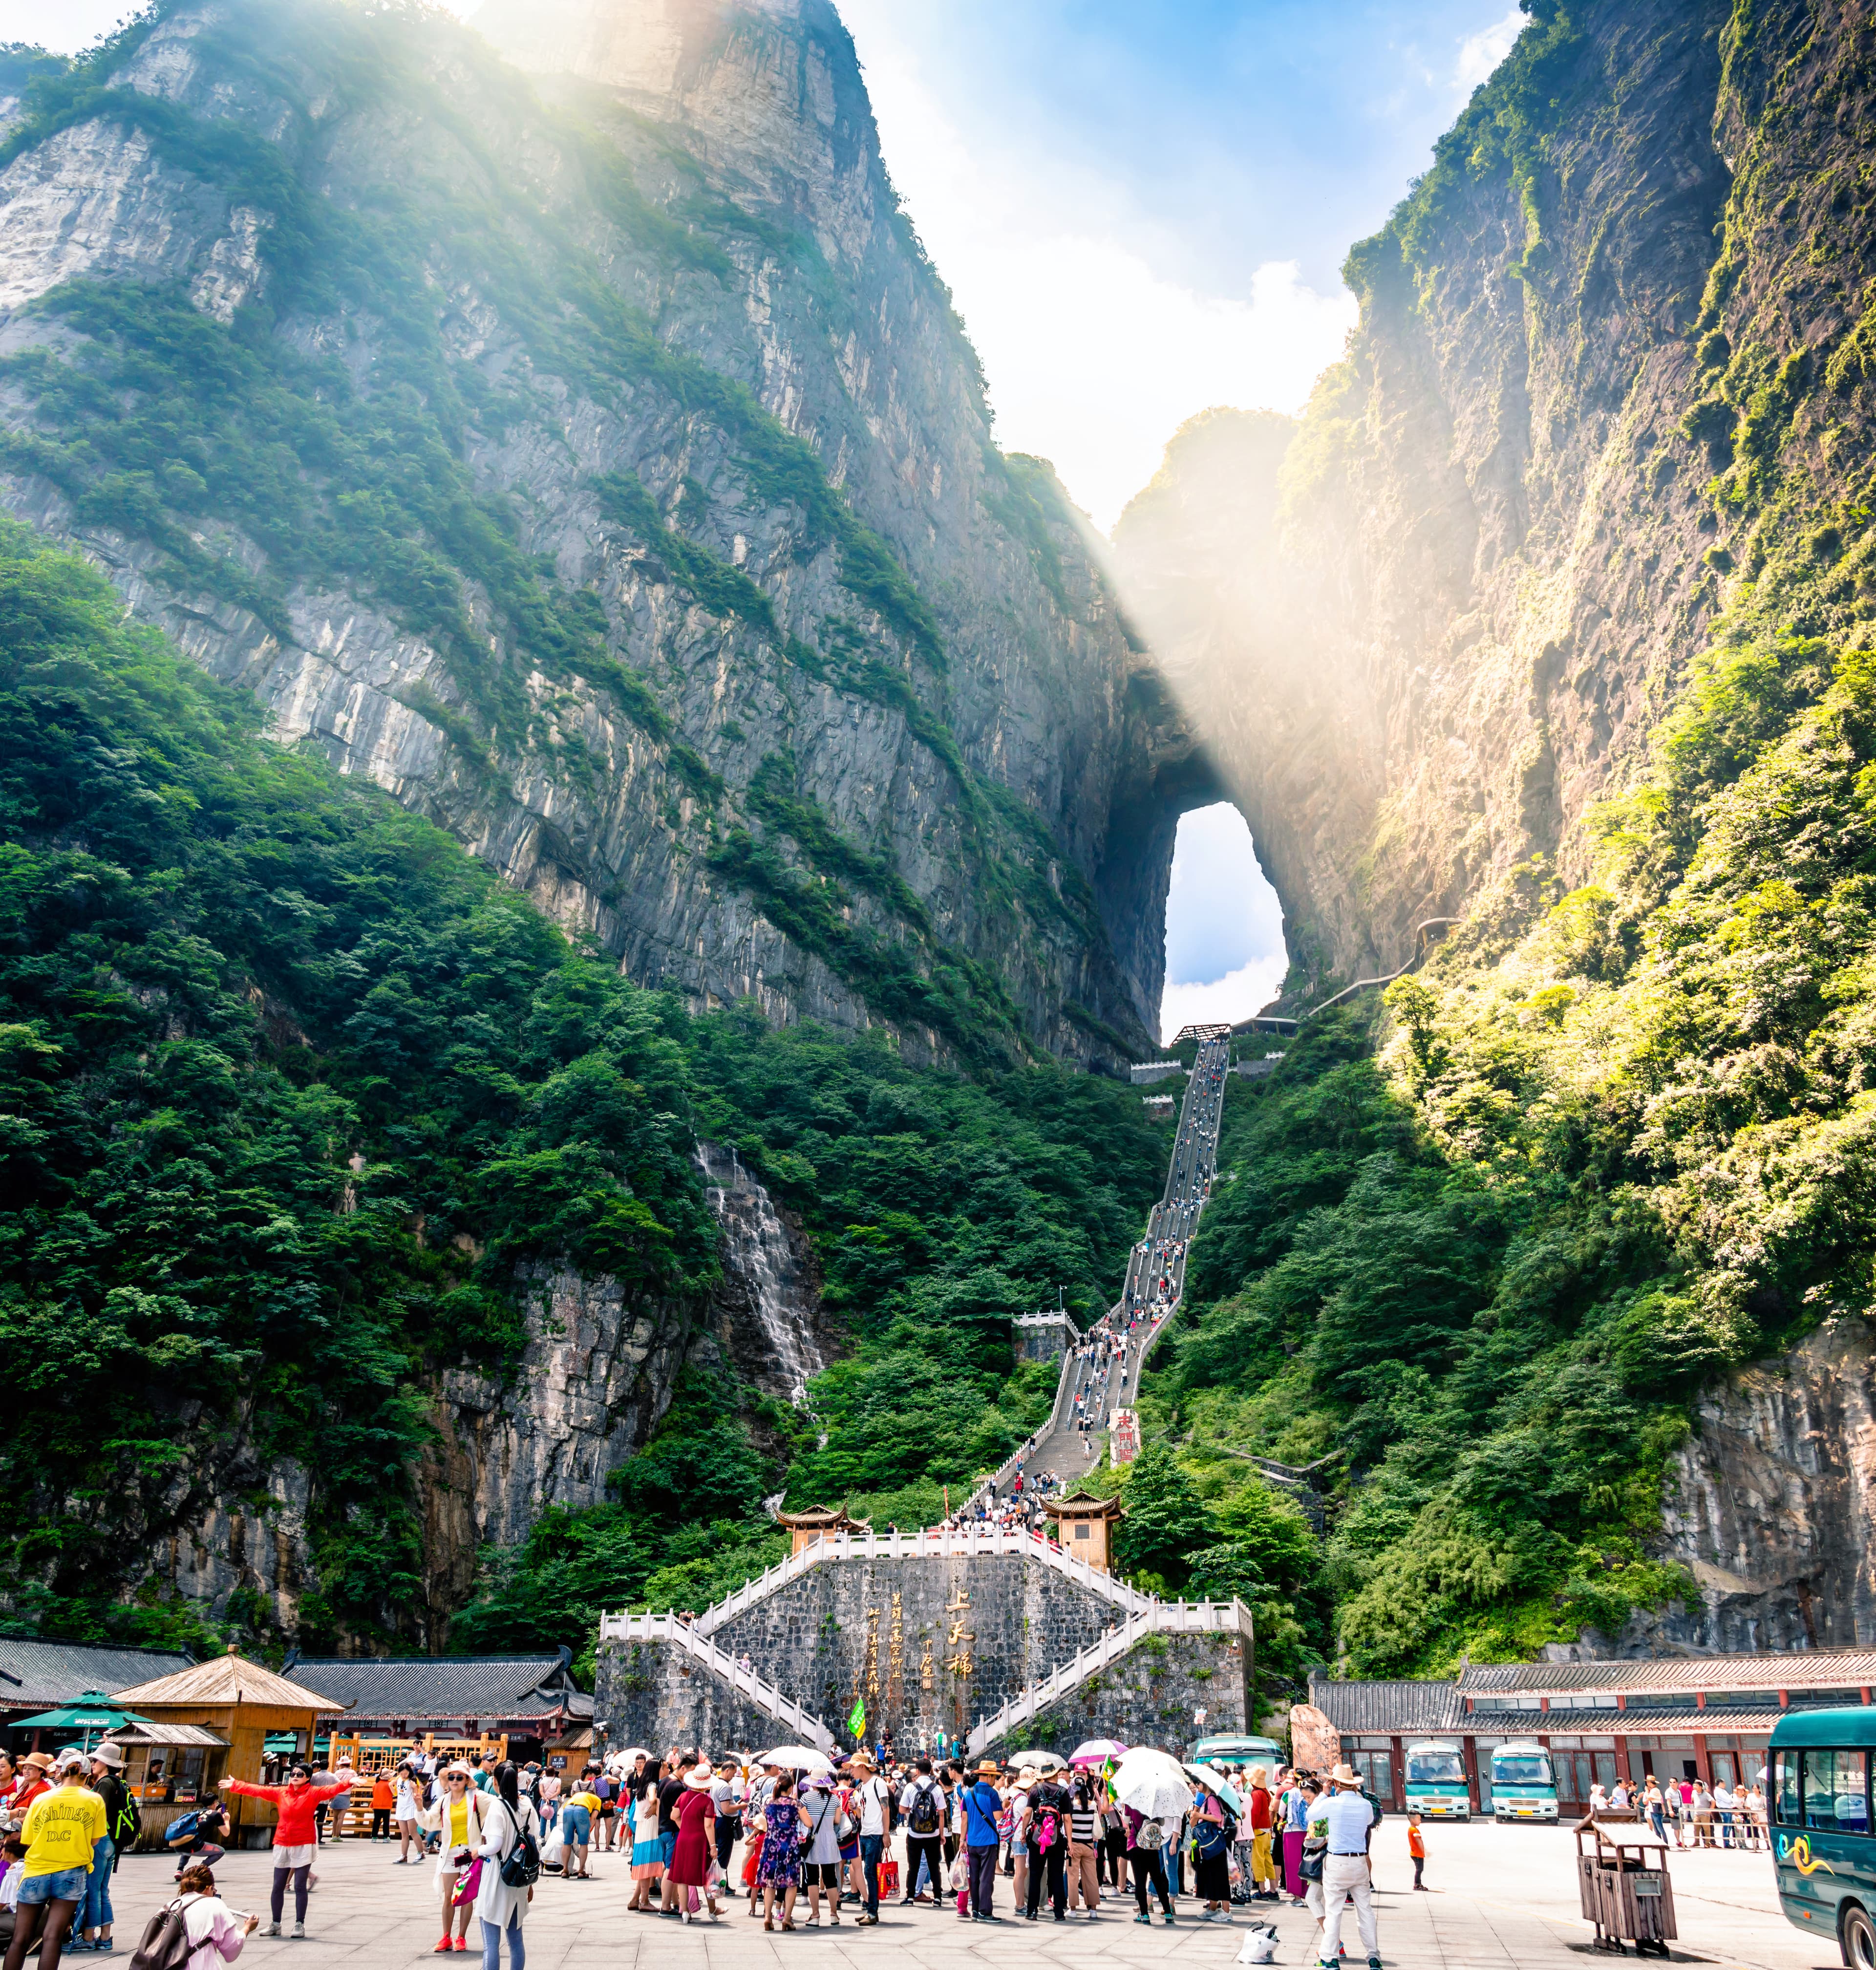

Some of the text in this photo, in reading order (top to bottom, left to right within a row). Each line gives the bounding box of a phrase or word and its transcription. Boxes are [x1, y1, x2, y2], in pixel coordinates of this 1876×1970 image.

[1118, 1416, 1133, 1461] 天門聖
[944, 1589, 974, 1681] 上天梯
[46, 1830, 71, 1842] D.C
